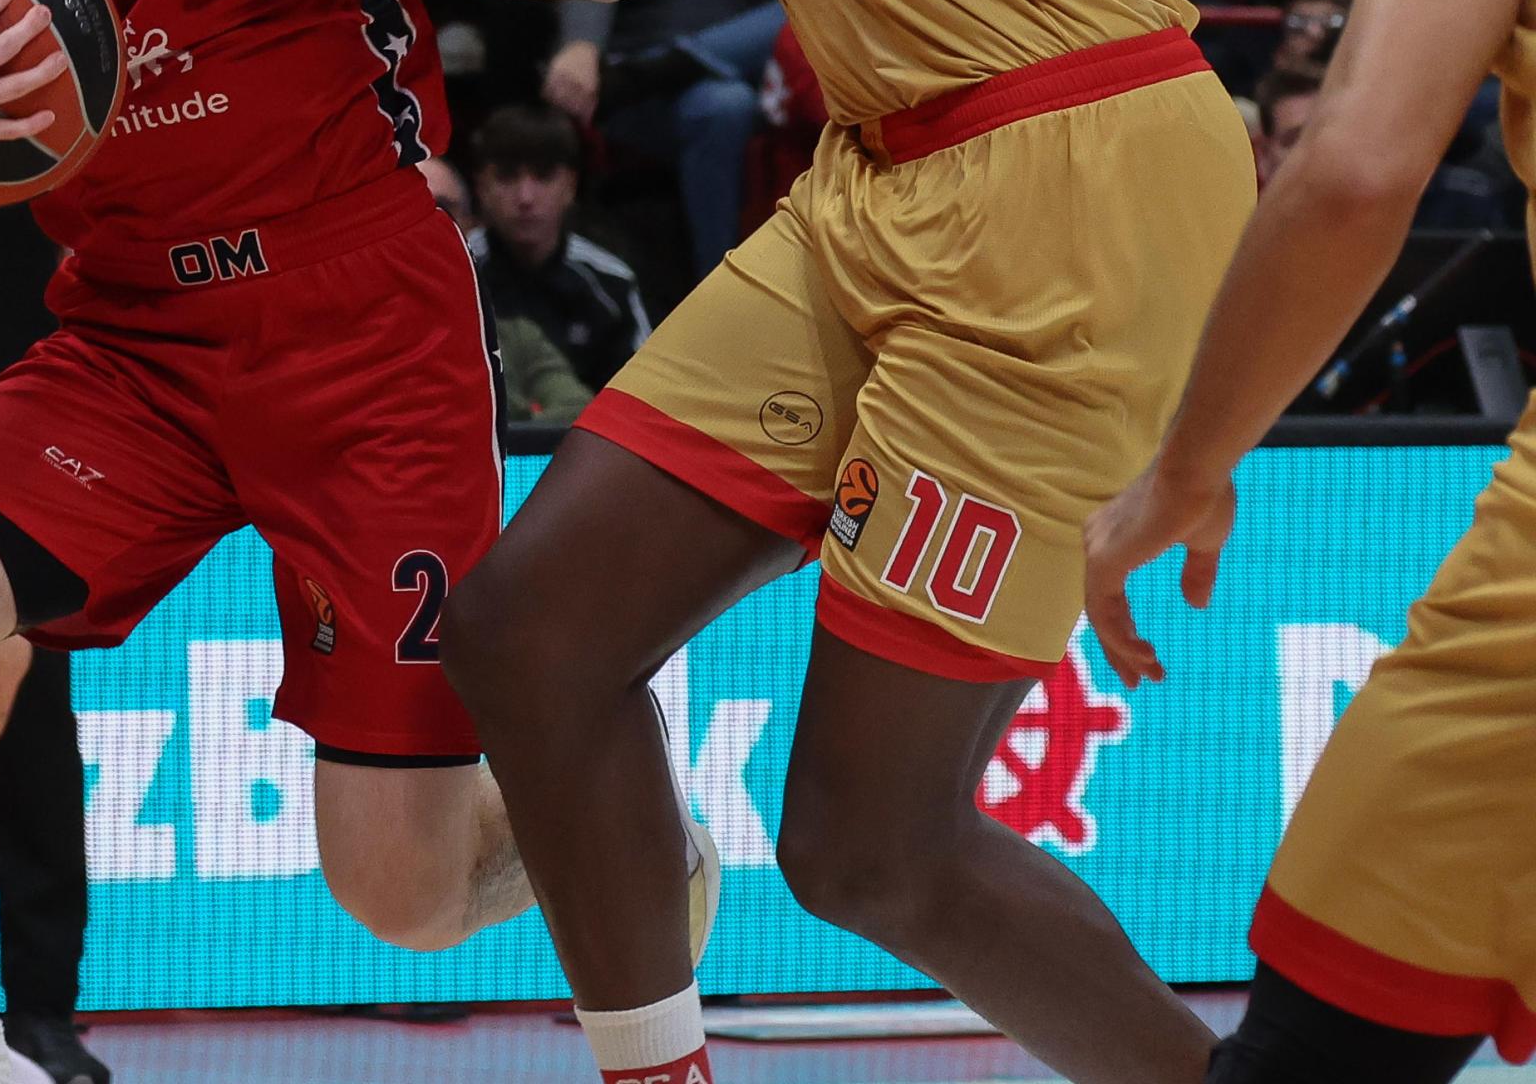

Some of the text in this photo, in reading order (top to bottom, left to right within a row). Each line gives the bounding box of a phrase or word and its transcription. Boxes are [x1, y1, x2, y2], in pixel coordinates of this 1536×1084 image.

[111, 91, 229, 137] nitude
[169, 228, 269, 286] OM
[768, 401, 813, 435] GSA
[880, 468, 1023, 624] 10
[392, 549, 449, 664] 2
